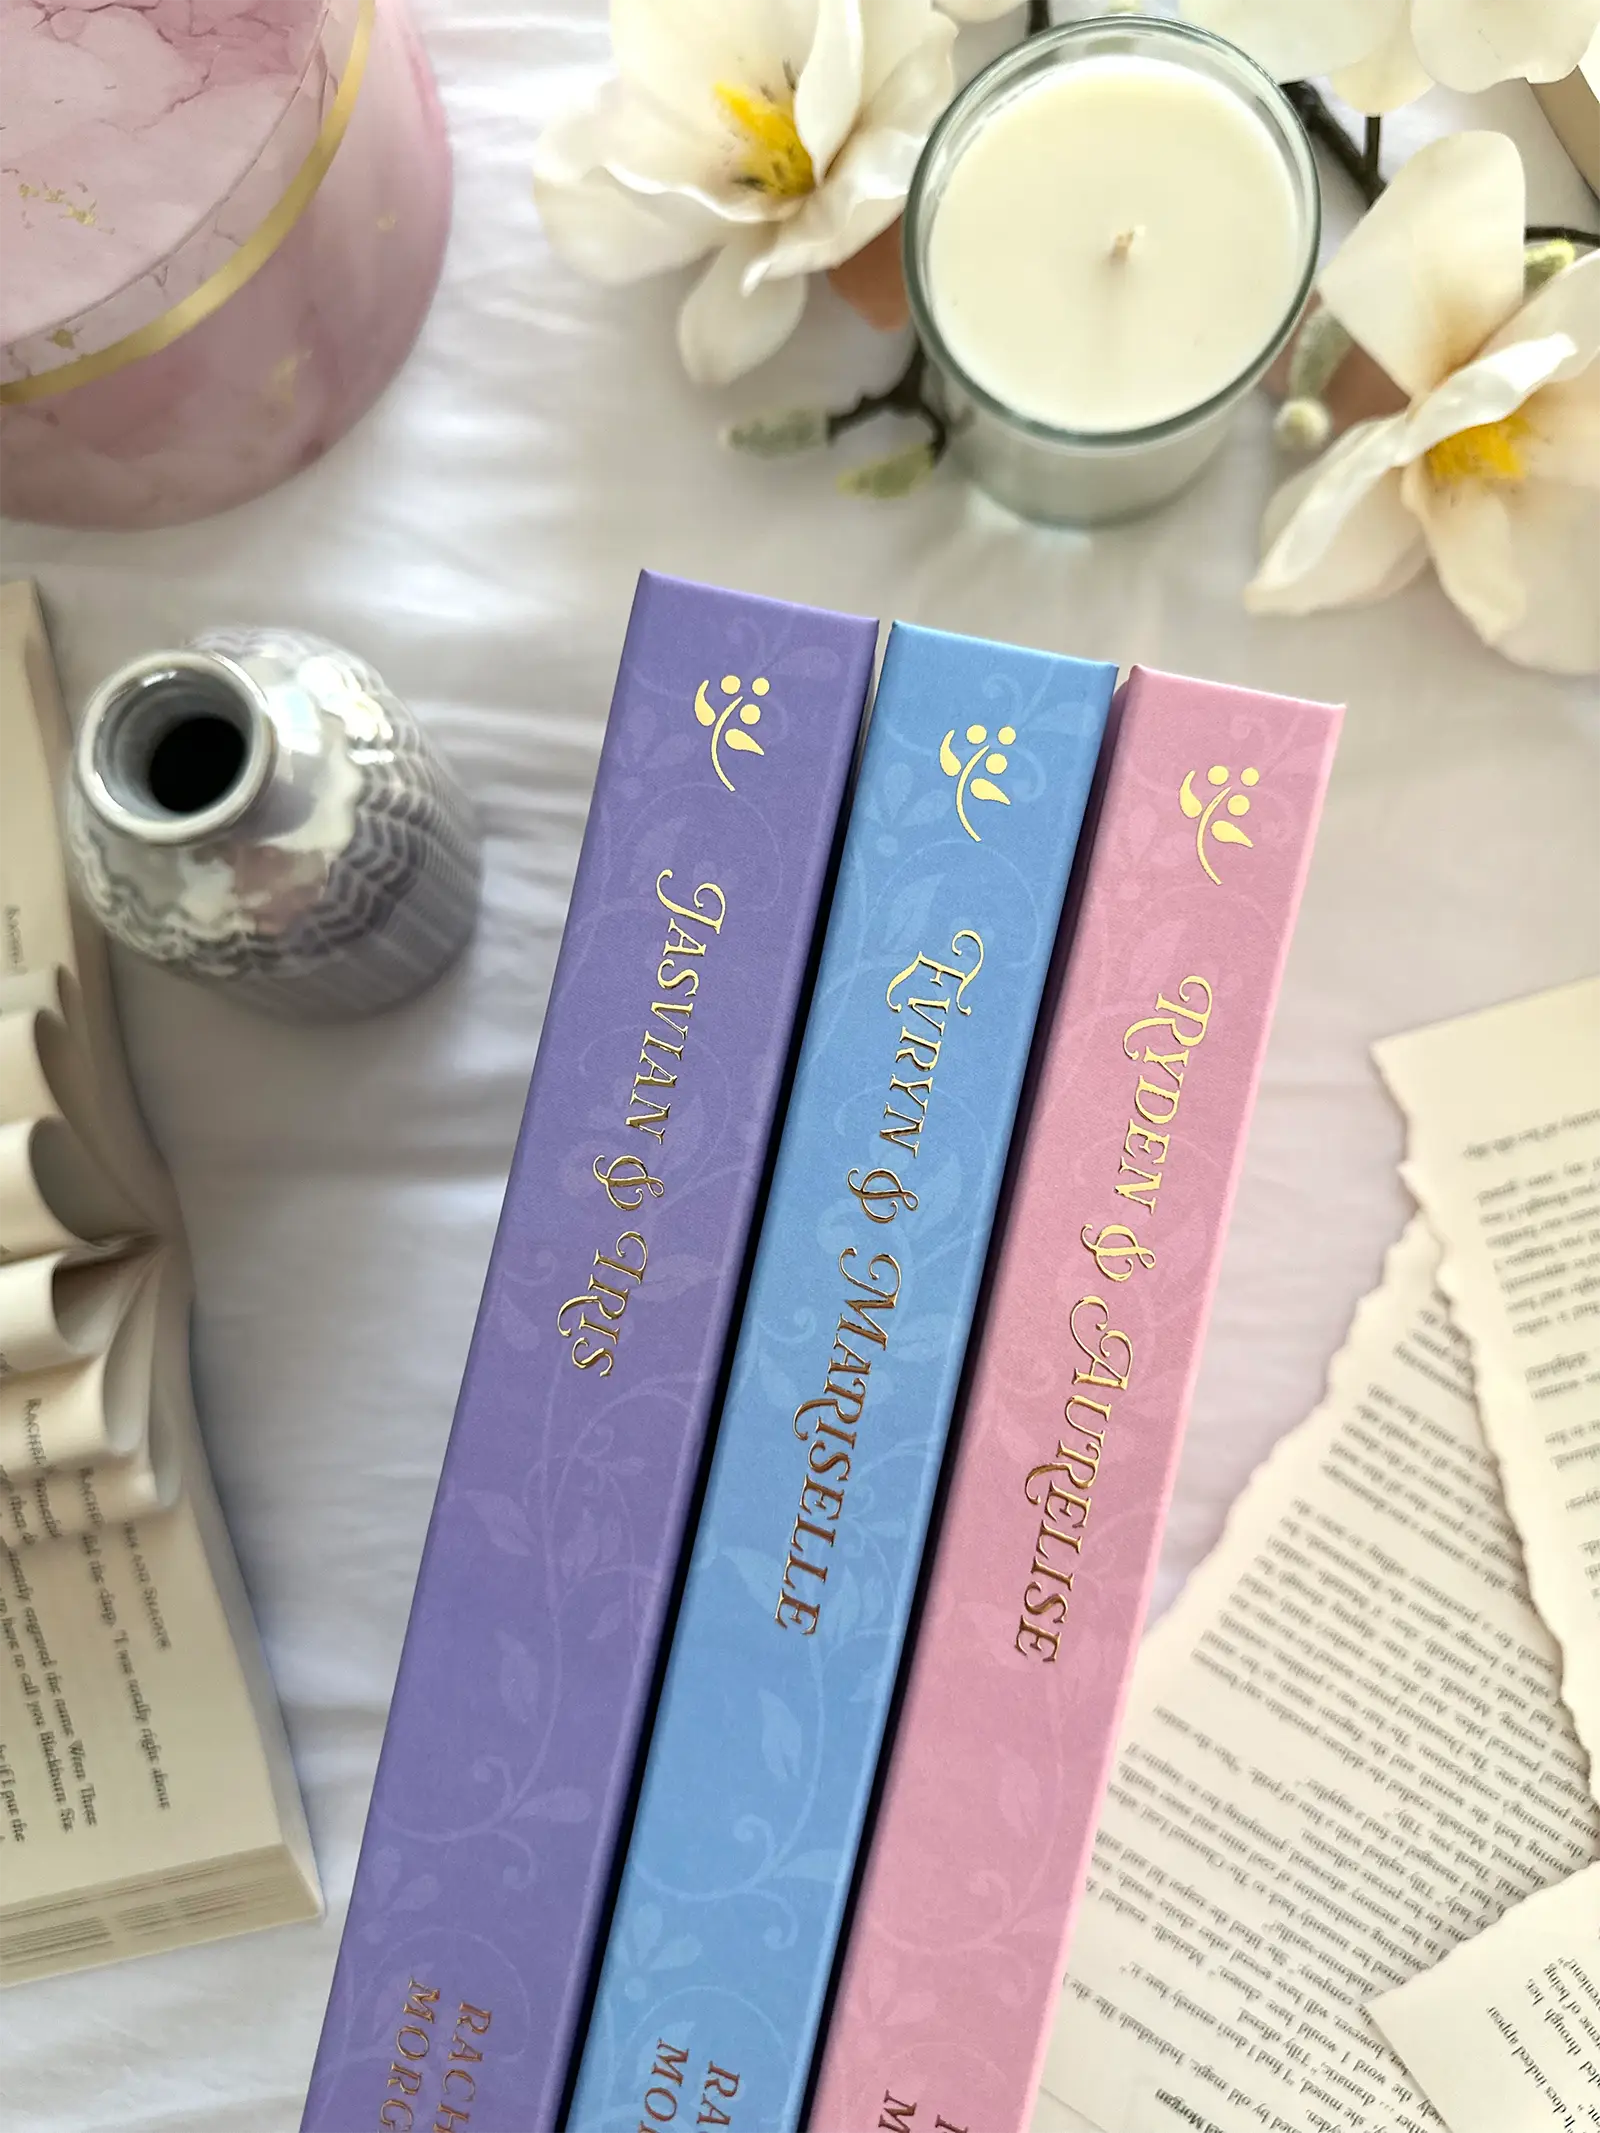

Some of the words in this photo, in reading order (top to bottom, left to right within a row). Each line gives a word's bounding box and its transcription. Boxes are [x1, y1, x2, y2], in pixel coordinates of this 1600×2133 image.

[623, 869, 727, 1145] JASVIAN
[879, 930, 985, 1159] EVRYN
[1113, 975, 1213, 1214] RYDEN
[593, 1154, 664, 1212] &
[847, 1167, 919, 1224] &
[1080, 1222, 1155, 1283] &
[557, 1231, 648, 1377] IRIS
[774, 1246, 902, 1637] MARISELLE
[1013, 1295, 1133, 1664] AURELISE
[1272, 1976, 1303, 2005] have
[1543, 1962, 1570, 2003] being
[1263, 1998, 1294, 2027] have
[1300, 1997, 1330, 2020] will
[1486, 2006, 1519, 2046] appear
[1561, 2000, 1581, 2016] of
[1281, 2035, 1314, 2067] Tilly
[1294, 2020, 1338, 2052] would
[1543, 2007, 1582, 2056] through
[378, 1976, 441, 2133] MORG
[1254, 2048, 1284, 2074] find
[1351, 2058, 1387, 2085] word
[1511, 2045, 1548, 2088] indeed
[696, 2059, 741, 2133] RA
[1155, 2087, 1207, 2130] Morgan
[1227, 2086, 1253, 2107] old
[1252, 2099, 1272, 2123] by
[1299, 2074, 1344, 2110] mused,
[1389, 2082, 1412, 2106] the
[1544, 2085, 1567, 2114] does
[1344, 2105, 1368, 2125] she
